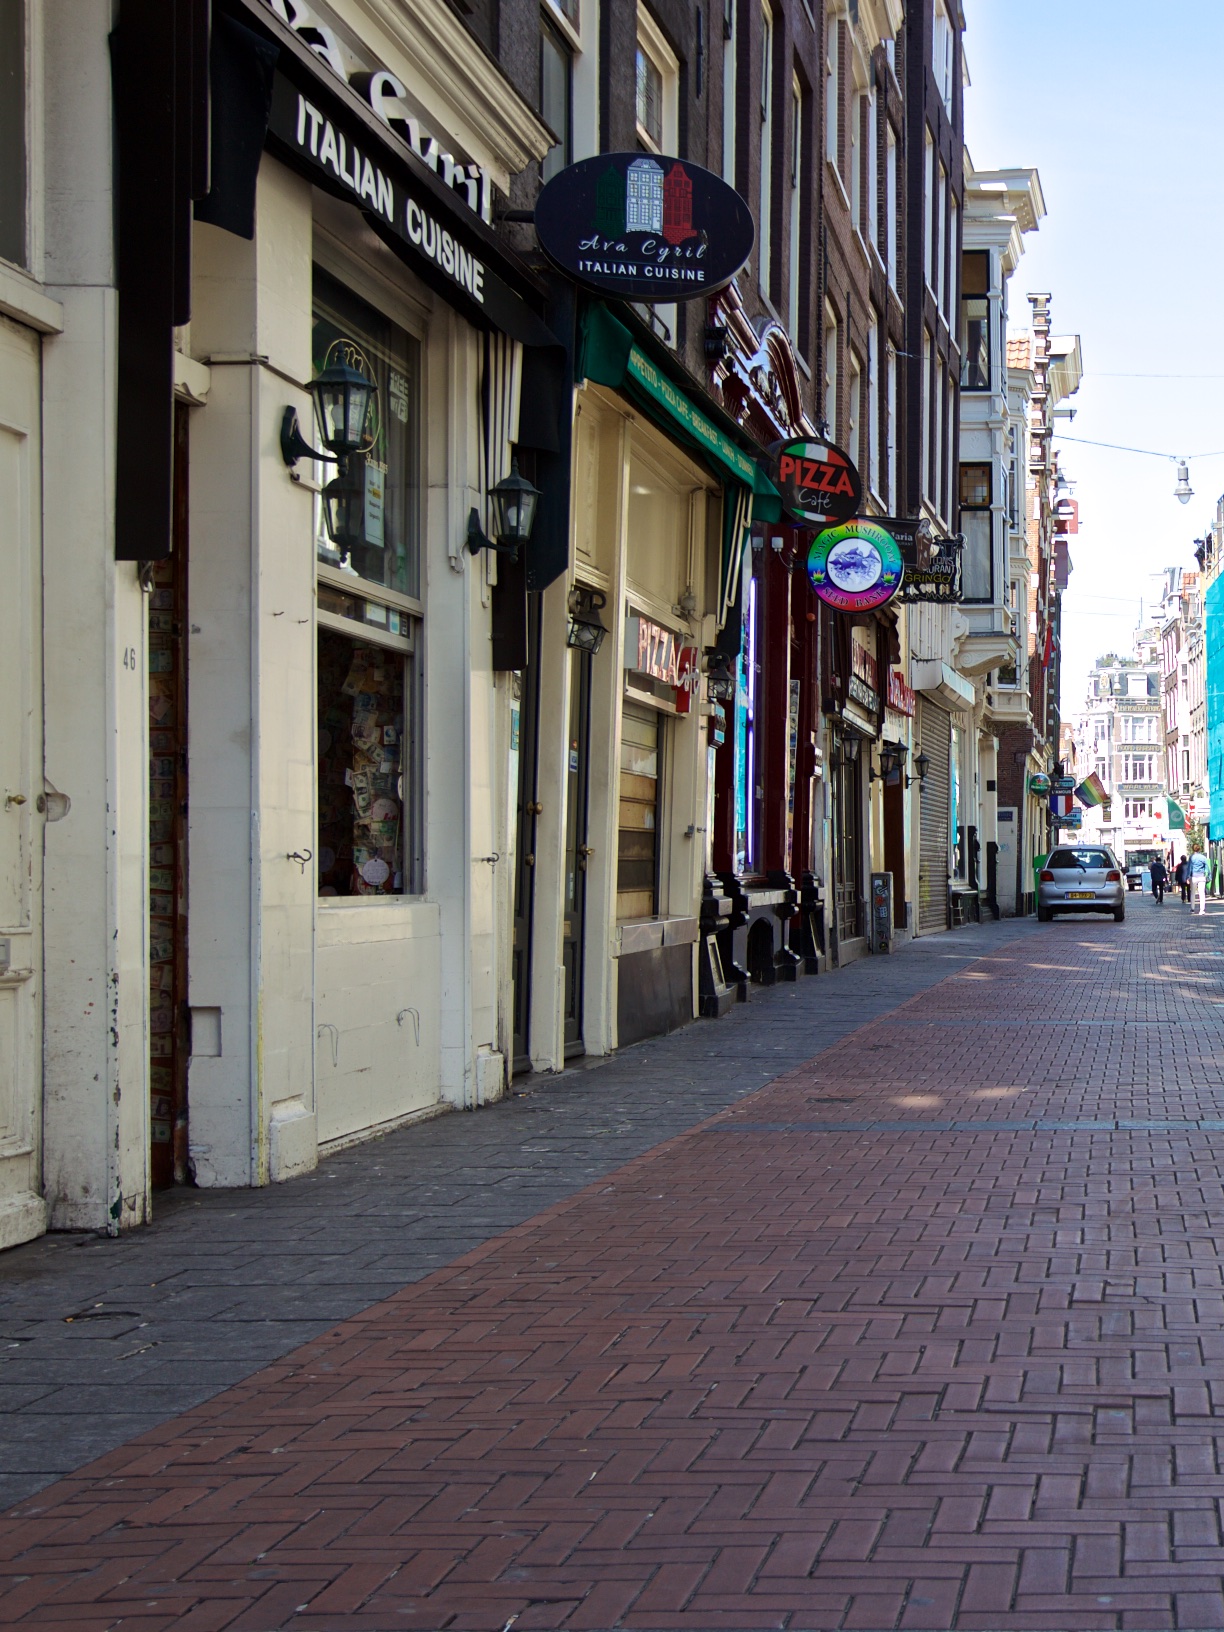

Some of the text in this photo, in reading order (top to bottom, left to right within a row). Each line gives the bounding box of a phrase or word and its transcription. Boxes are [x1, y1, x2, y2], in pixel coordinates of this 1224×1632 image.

[296, 94, 485, 304] ITALIAN CUISINE
[578, 234, 708, 263] Ava Cyril
[578, 260, 706, 282] ITALIAN CUISINE
[780, 455, 855, 497] PIZZA
[798, 489, 832, 513] Café
[815, 525, 896, 563] MAGIC MUSHROOM
[904, 573, 951, 583] GRINGO
[823, 587, 886, 607] SEED BANK
[124, 648, 135, 670] 46
[638, 616, 677, 687] PIZZA
